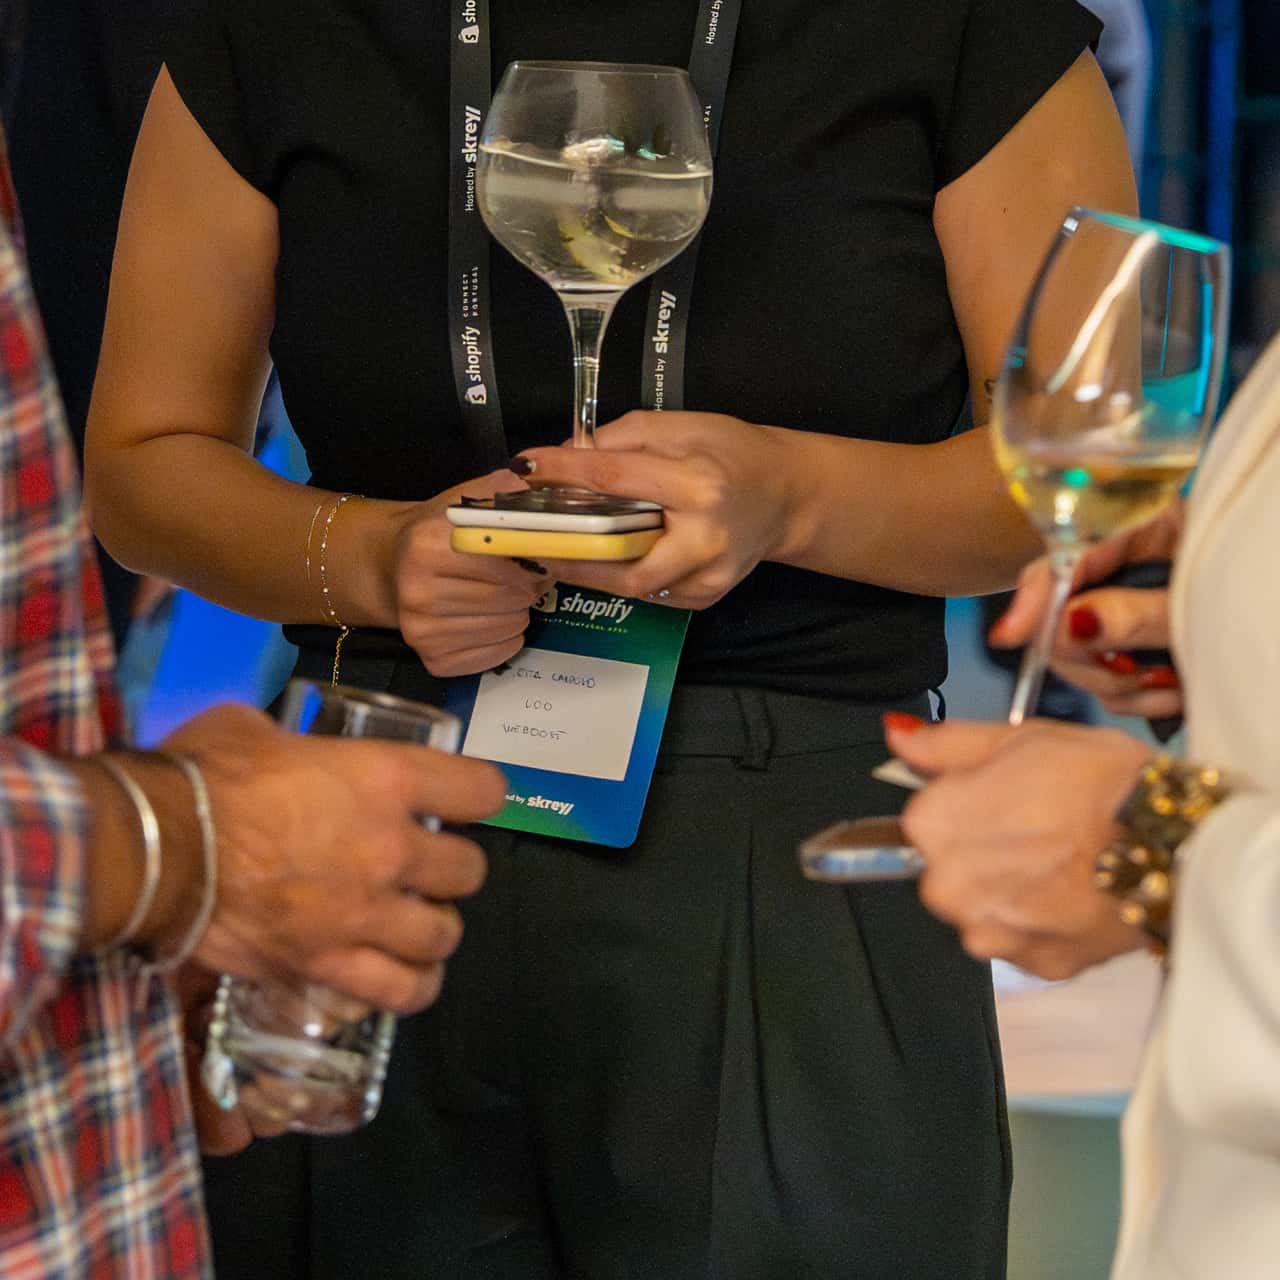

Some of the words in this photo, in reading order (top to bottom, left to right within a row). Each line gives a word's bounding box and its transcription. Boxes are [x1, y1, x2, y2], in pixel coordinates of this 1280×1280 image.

[705, 10, 720, 45] Hosted
[465, 166, 478, 178] by
[464, 179, 475, 212] Hosted
[463, 325, 483, 382] shopify
[654, 358, 667, 375] by
[654, 376, 665, 411] Hosted
[560, 593, 633, 624] shopify
